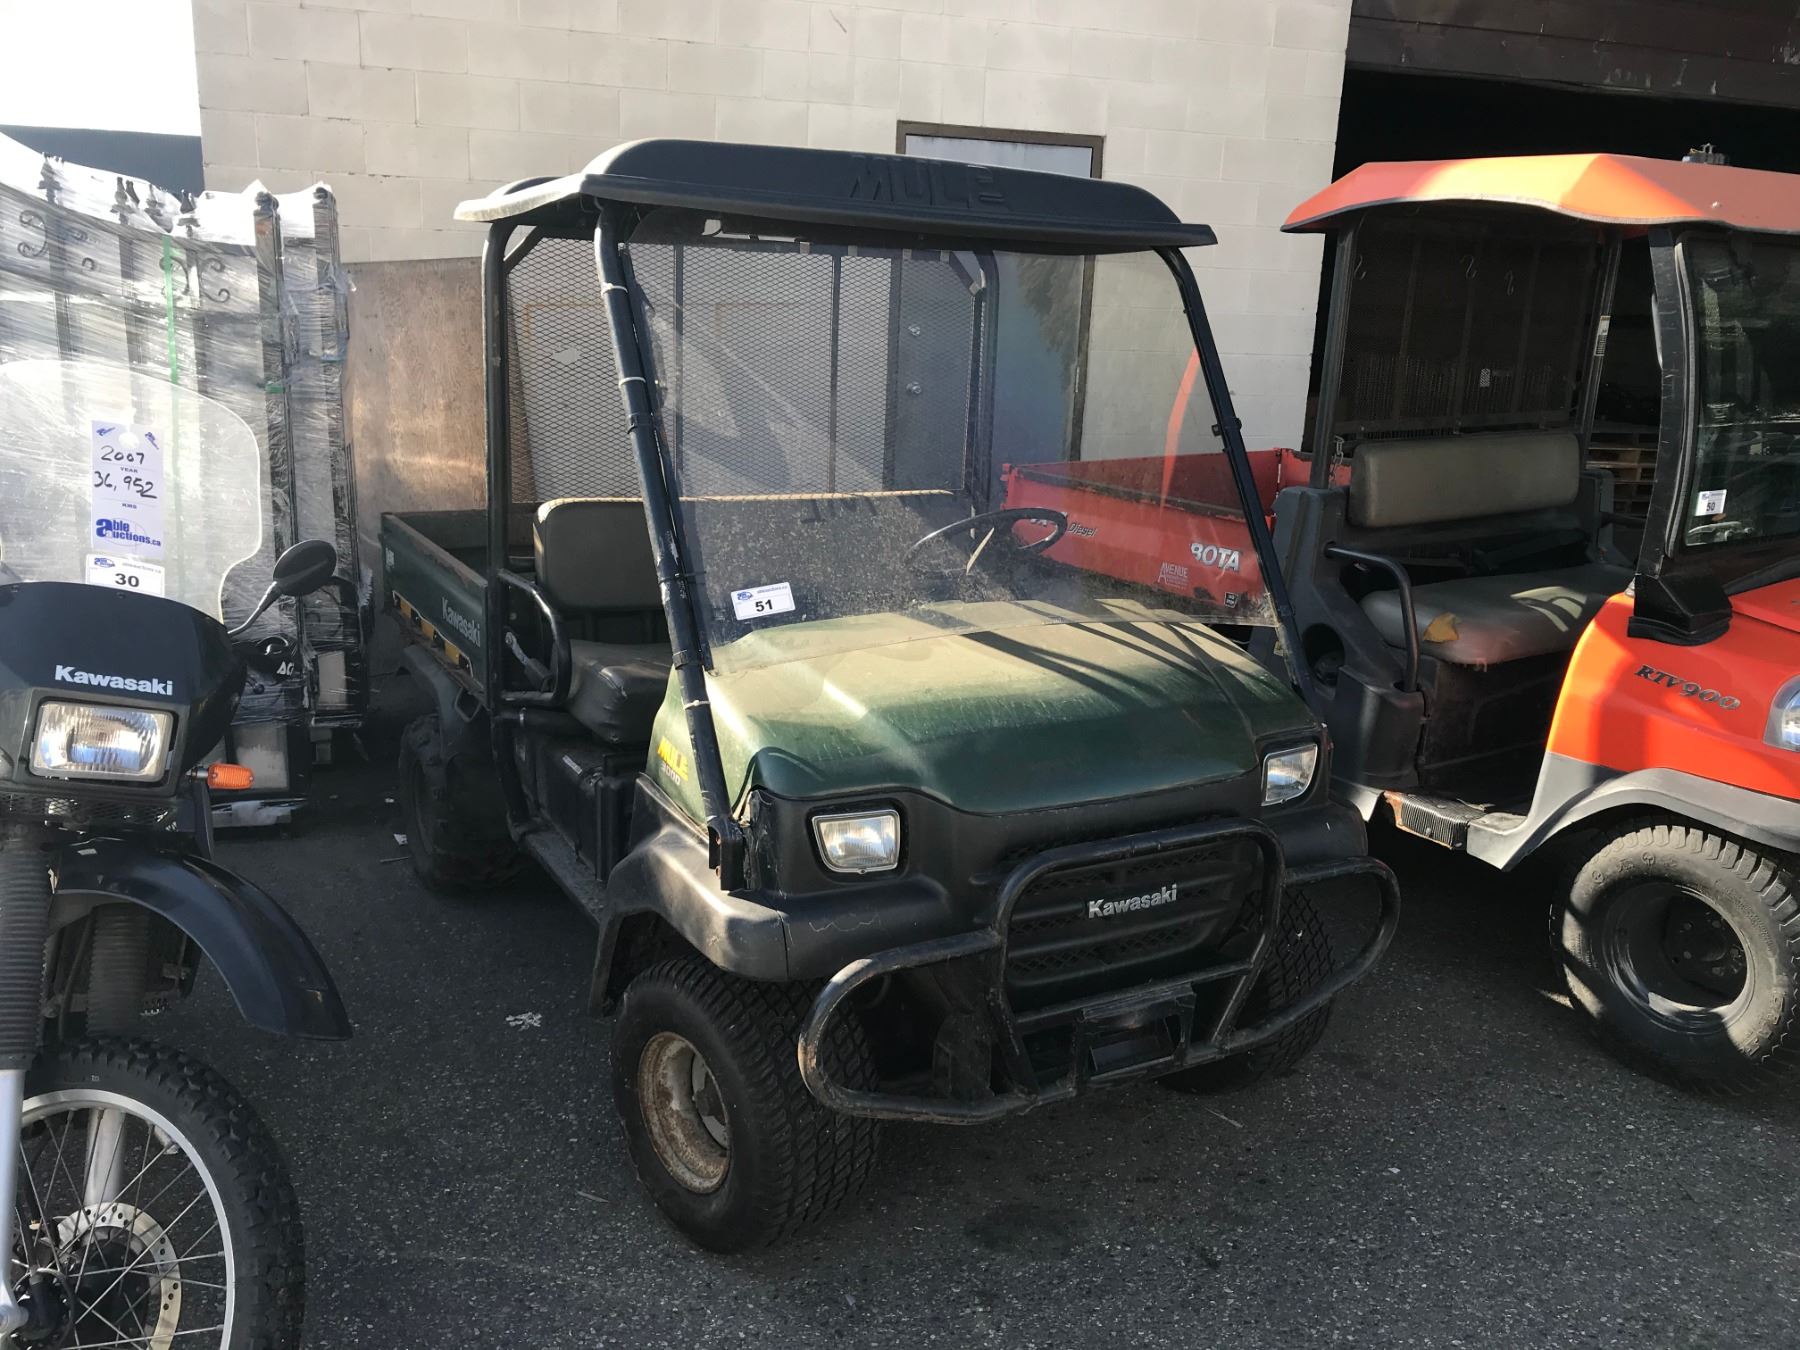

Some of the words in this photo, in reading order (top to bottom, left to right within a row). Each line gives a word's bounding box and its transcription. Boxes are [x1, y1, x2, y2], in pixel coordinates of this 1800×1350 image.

[101, 445, 145, 465] 2007
[1706, 502, 1716, 512] 50
[1068, 522, 1098, 537] Diesel
[115, 573, 140, 588] 30
[1158, 561, 1189, 586] AVENUE
[755, 599, 773, 613] 51
[442, 596, 481, 648] Kawasaki
[54, 665, 174, 696] Kawasaki
[1634, 664, 1741, 710] RTV900
[1088, 883, 1178, 918] Kawasaki
